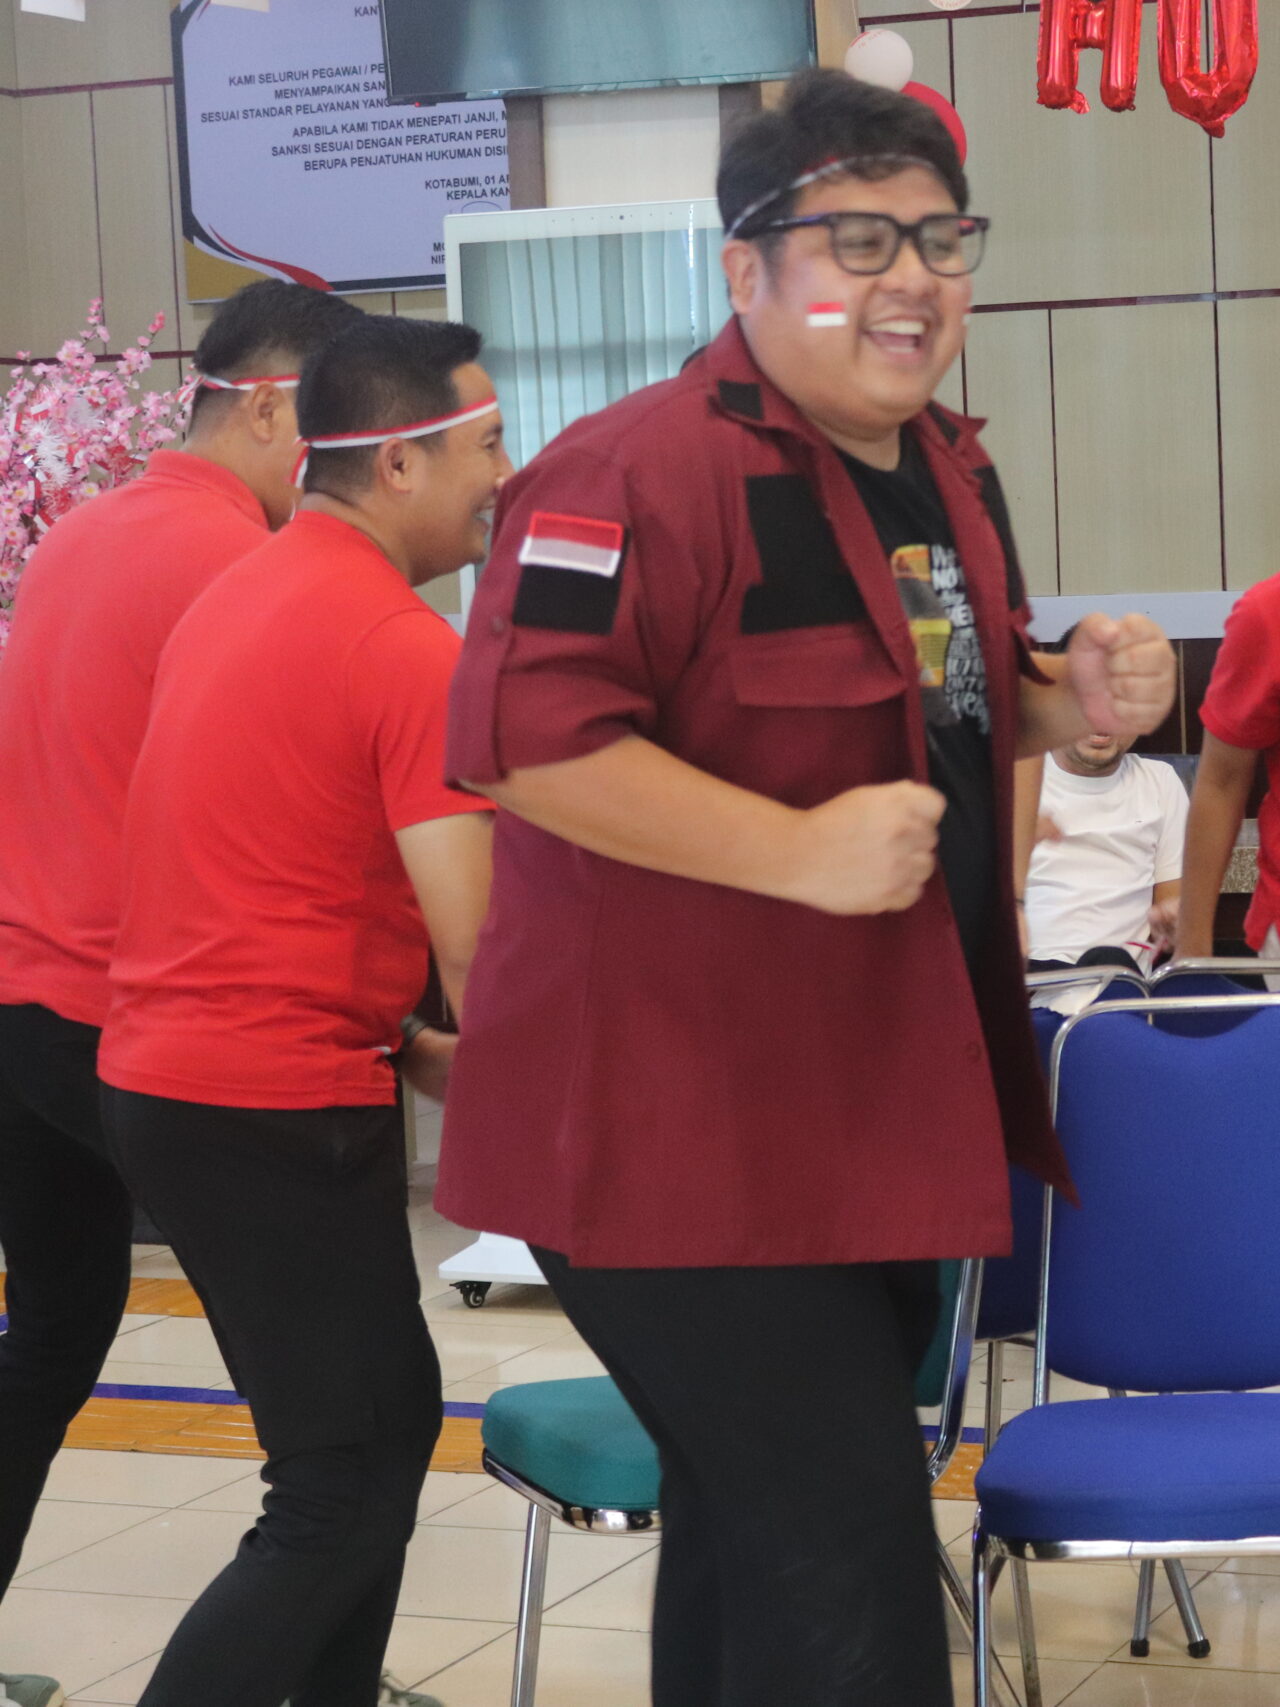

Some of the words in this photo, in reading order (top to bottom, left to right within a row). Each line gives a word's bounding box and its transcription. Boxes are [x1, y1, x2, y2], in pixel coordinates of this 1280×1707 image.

[354, 6, 379, 17] KAN
[229, 75, 256, 87] KAMI
[258, 70, 309, 84] SELURUH
[312, 65, 362, 79] PEGAWAI
[371, 63, 385, 73] PE
[274, 83, 361, 100] MENYAMPAIKAN
[364, 80, 386, 92] SAN
[200, 110, 240, 123] SESUAI
[242, 105, 293, 120] STANDAR
[295, 99, 360, 116] PELAYANAN
[292, 123, 338, 138] APABILA
[341, 121, 368, 134] KAMI
[371, 119, 405, 132] TIDAK
[407, 114, 462, 128] MENEPATI
[464, 111, 499, 124] JANJI,
[271, 144, 312, 157] SANKSI
[314, 141, 353, 154] SESUAI
[356, 136, 403, 151] DENGAN
[405, 130, 473, 147] PERATURAN
[475, 128, 506, 140] PERU
[304, 157, 348, 172] BERUPA
[350, 152, 423, 168] PENJATUHAN
[425, 147, 482, 162] HUKUMAN
[484, 145, 508, 157] DISI
[424, 176, 482, 190] KOTABUMI,
[484, 175, 496, 186] 01
[446, 188, 488, 201] KEPALA
[490, 186, 511, 198] KAN
